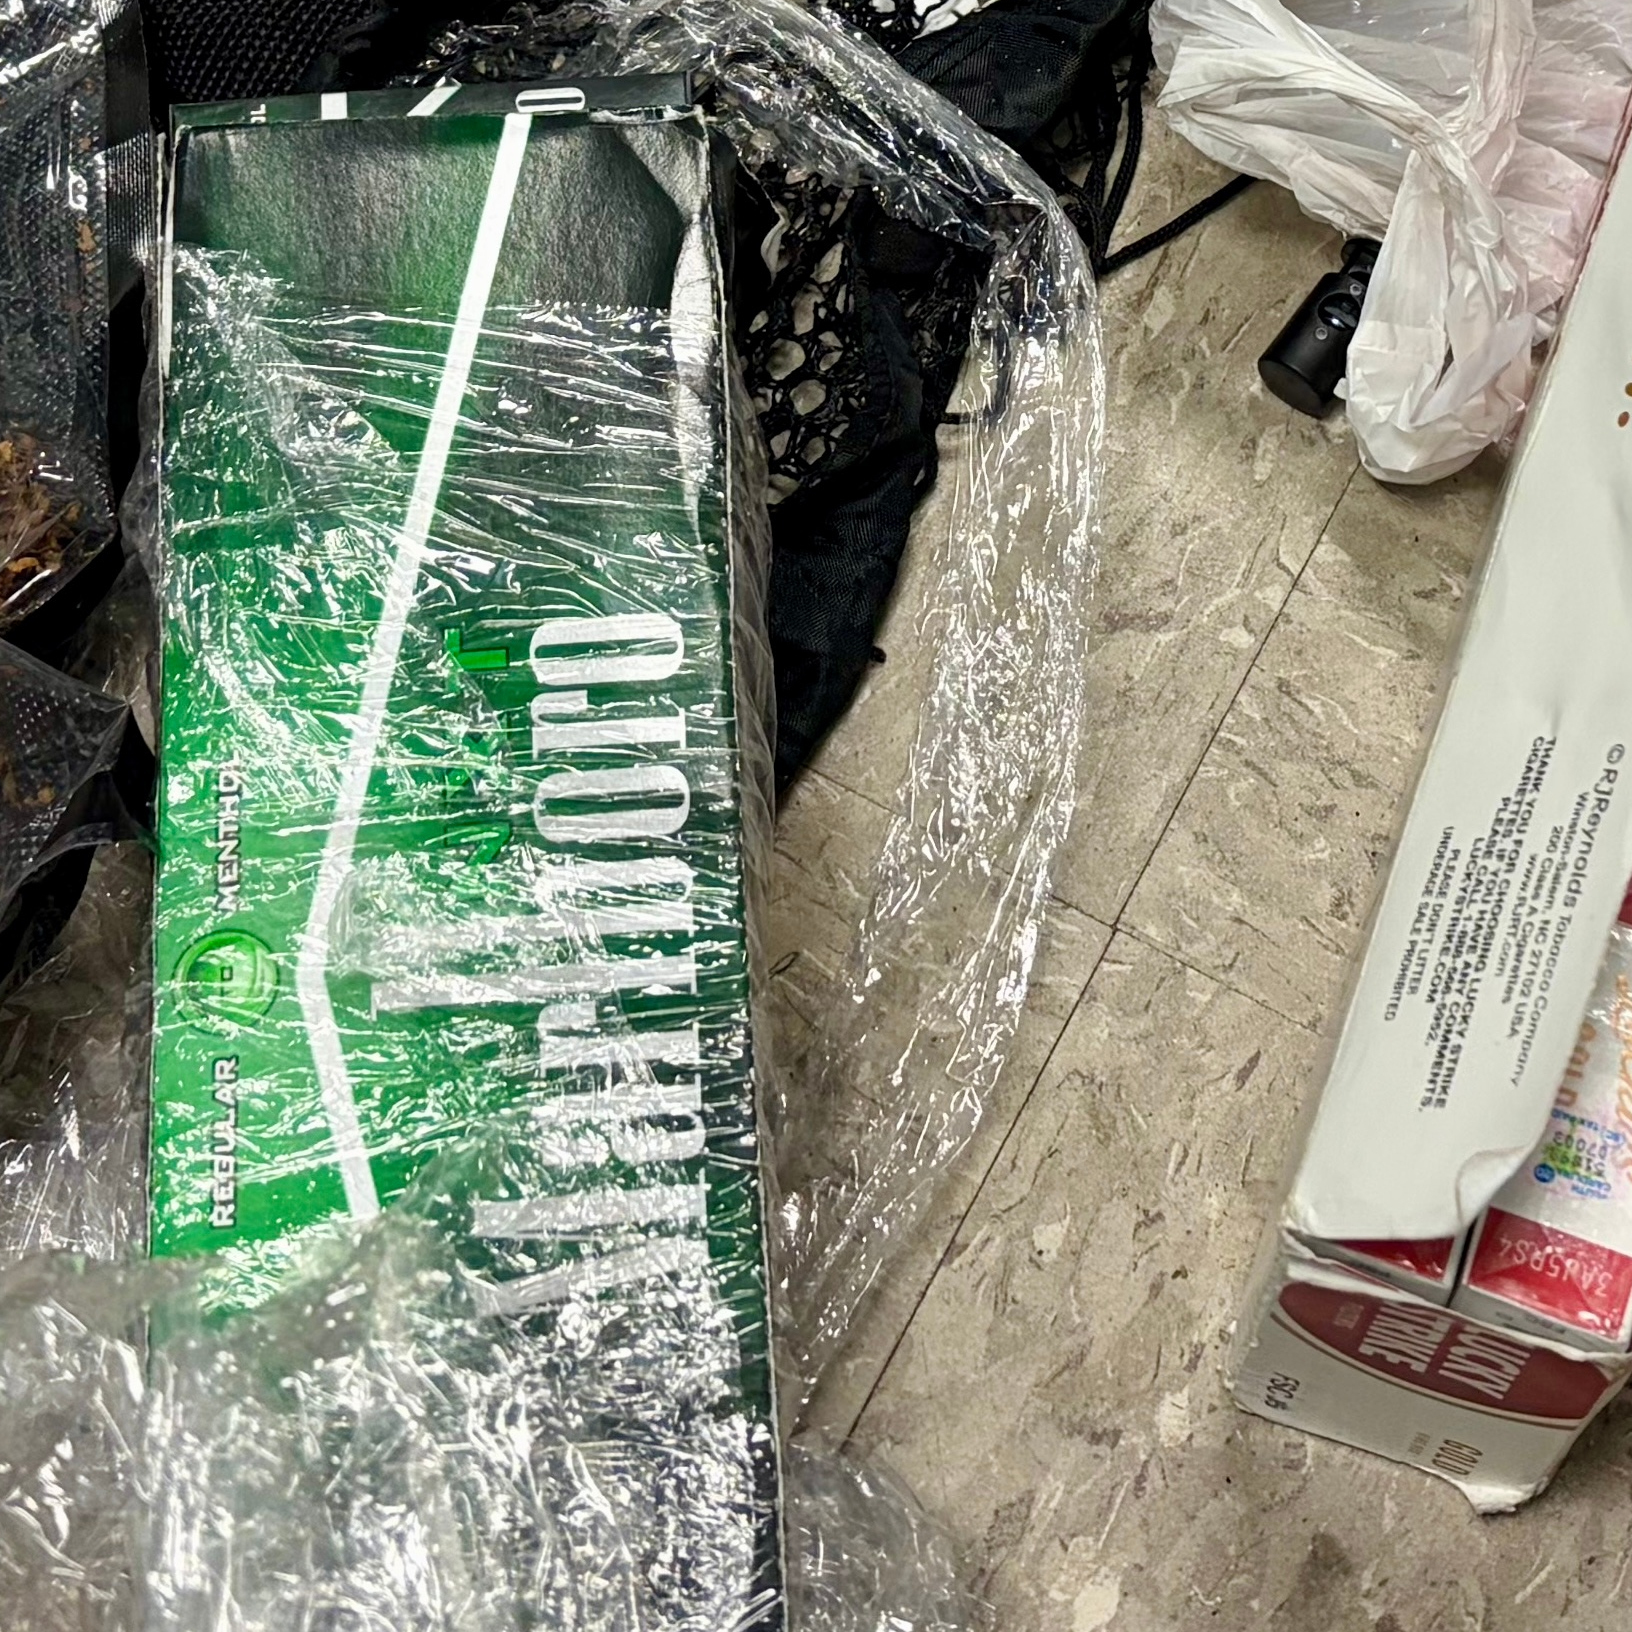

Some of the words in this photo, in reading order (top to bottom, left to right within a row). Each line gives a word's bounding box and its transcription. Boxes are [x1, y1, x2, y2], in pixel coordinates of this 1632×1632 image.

[1528, 734, 1557, 796] THANK
[212, 757, 245, 915] MENTHOL
[1481, 794, 1511, 863] PLEASE
[1515, 796, 1537, 836] YOU
[1544, 823, 1563, 855] 200
[1420, 823, 1453, 899] UNDERAGE
[1434, 846, 1460, 901] PLEASE
[1493, 846, 1507, 863] IF
[1503, 837, 1524, 876] FOR
[1530, 855, 1554, 902] Class
[1465, 862, 1487, 911] CALL
[1480, 867, 1500, 905] YOU
[1409, 899, 1429, 936] SALE
[1421, 901, 1444, 946] DON'T
[1424, 834, 1484, 1006] LUCKYSTRIKE.COM
[1464, 907, 1488, 957] HAVE
[1472, 875, 1511, 975] CHOOSING
[1525, 904, 1539, 919] A
[1533, 918, 1550, 946] NC
[1405, 946, 1429, 997] LITTER
[1499, 918, 1535, 1007] Cigarettes
[1518, 947, 1543, 1000] 27102
[1537, 910, 1573, 994] Tobacco
[1382, 937, 1418, 1023] PROHIBITED
[1452, 959, 1472, 996] ANY
[1453, 975, 1482, 1039] LUCKY
[1504, 1000, 1527, 1041] USA
[1508, 993, 1549, 1089] Company
[1433, 1041, 1463, 1111] STRIKE
[209, 1055, 240, 1230] REGULAR
[1264, 1370, 1301, 1400] FSC
[1429, 1436, 1484, 1479] GOLD
